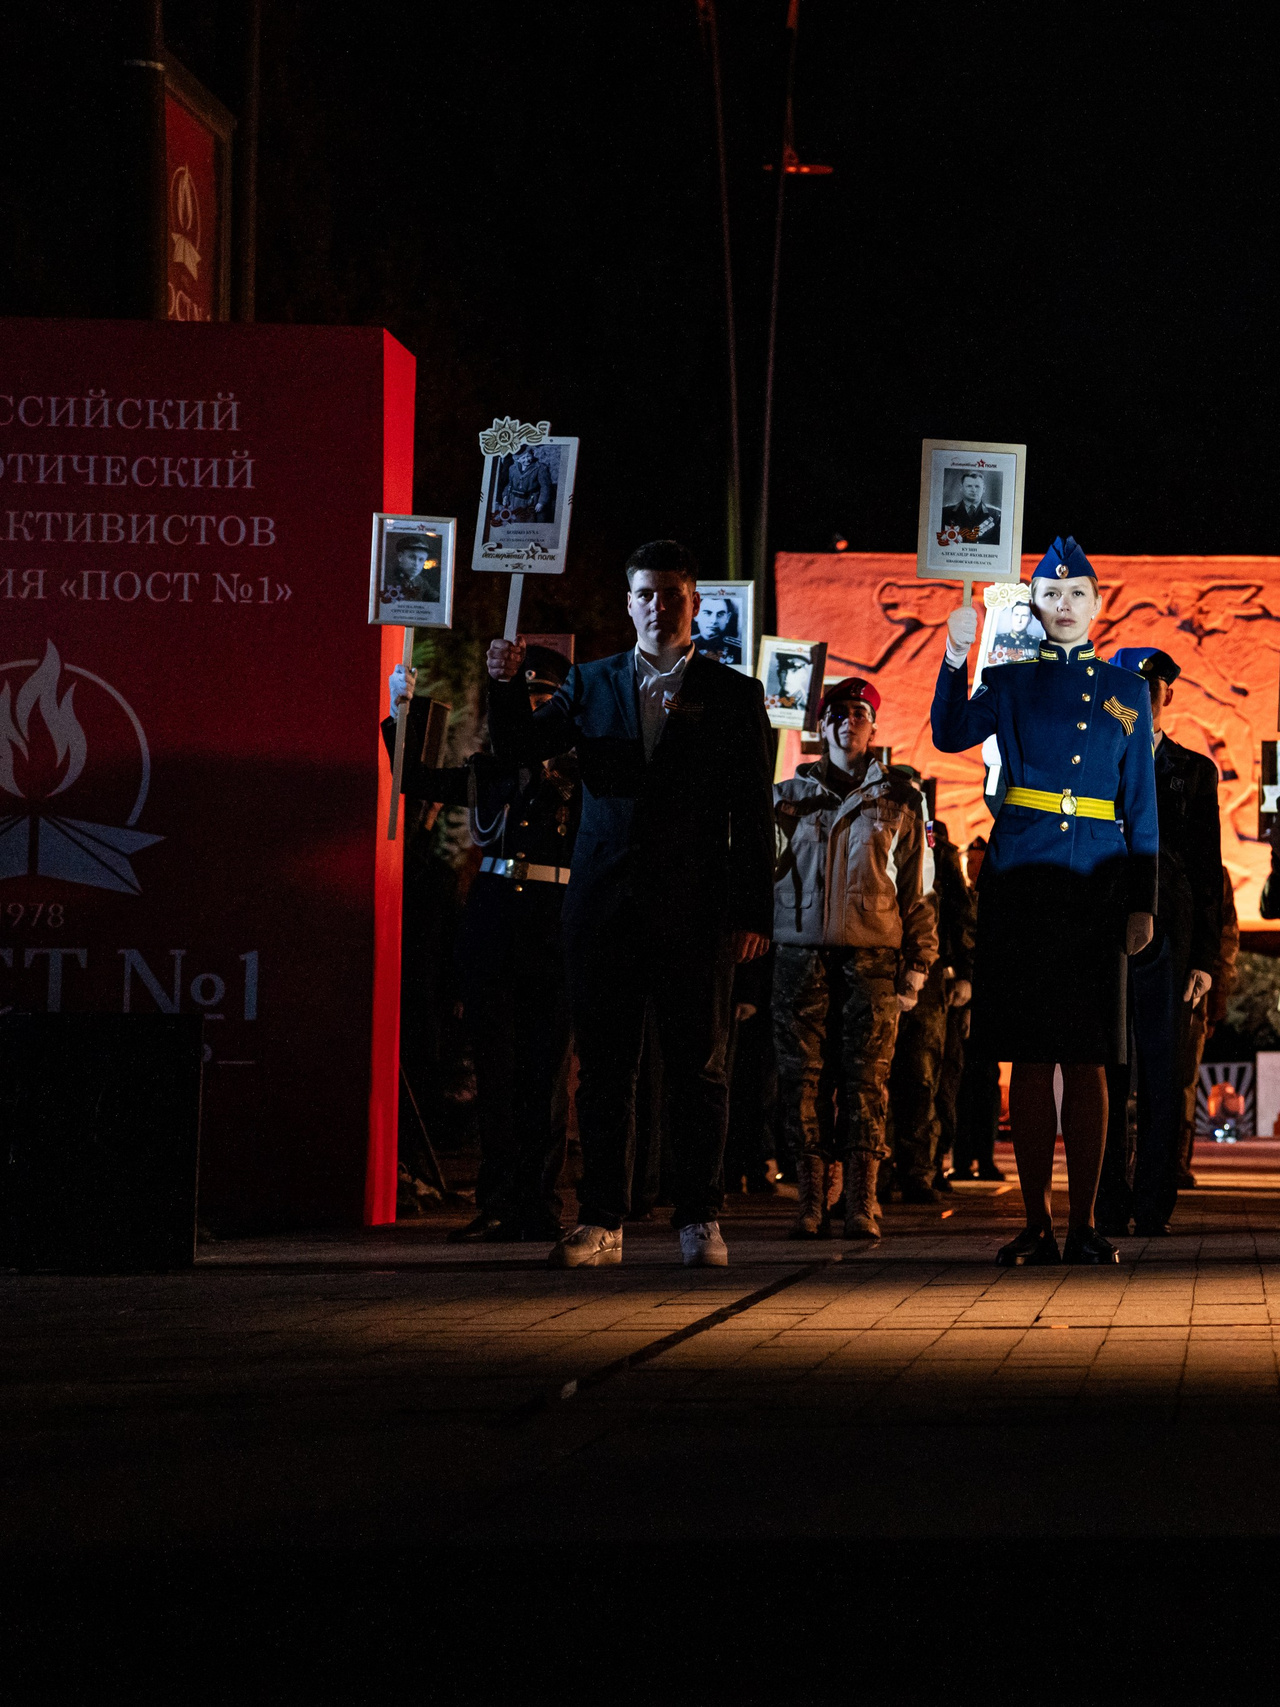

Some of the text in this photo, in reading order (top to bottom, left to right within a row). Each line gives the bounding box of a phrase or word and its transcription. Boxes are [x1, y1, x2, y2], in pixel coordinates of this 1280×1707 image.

[0, 450, 256, 489] ТИЧЕСКИЙ
[0, 511, 276, 546] КТИВИСТОВ
[60, 570, 200, 603] «ПОСТ
[212, 573, 293, 605] №1»
[0, 948, 88, 1013] Т
